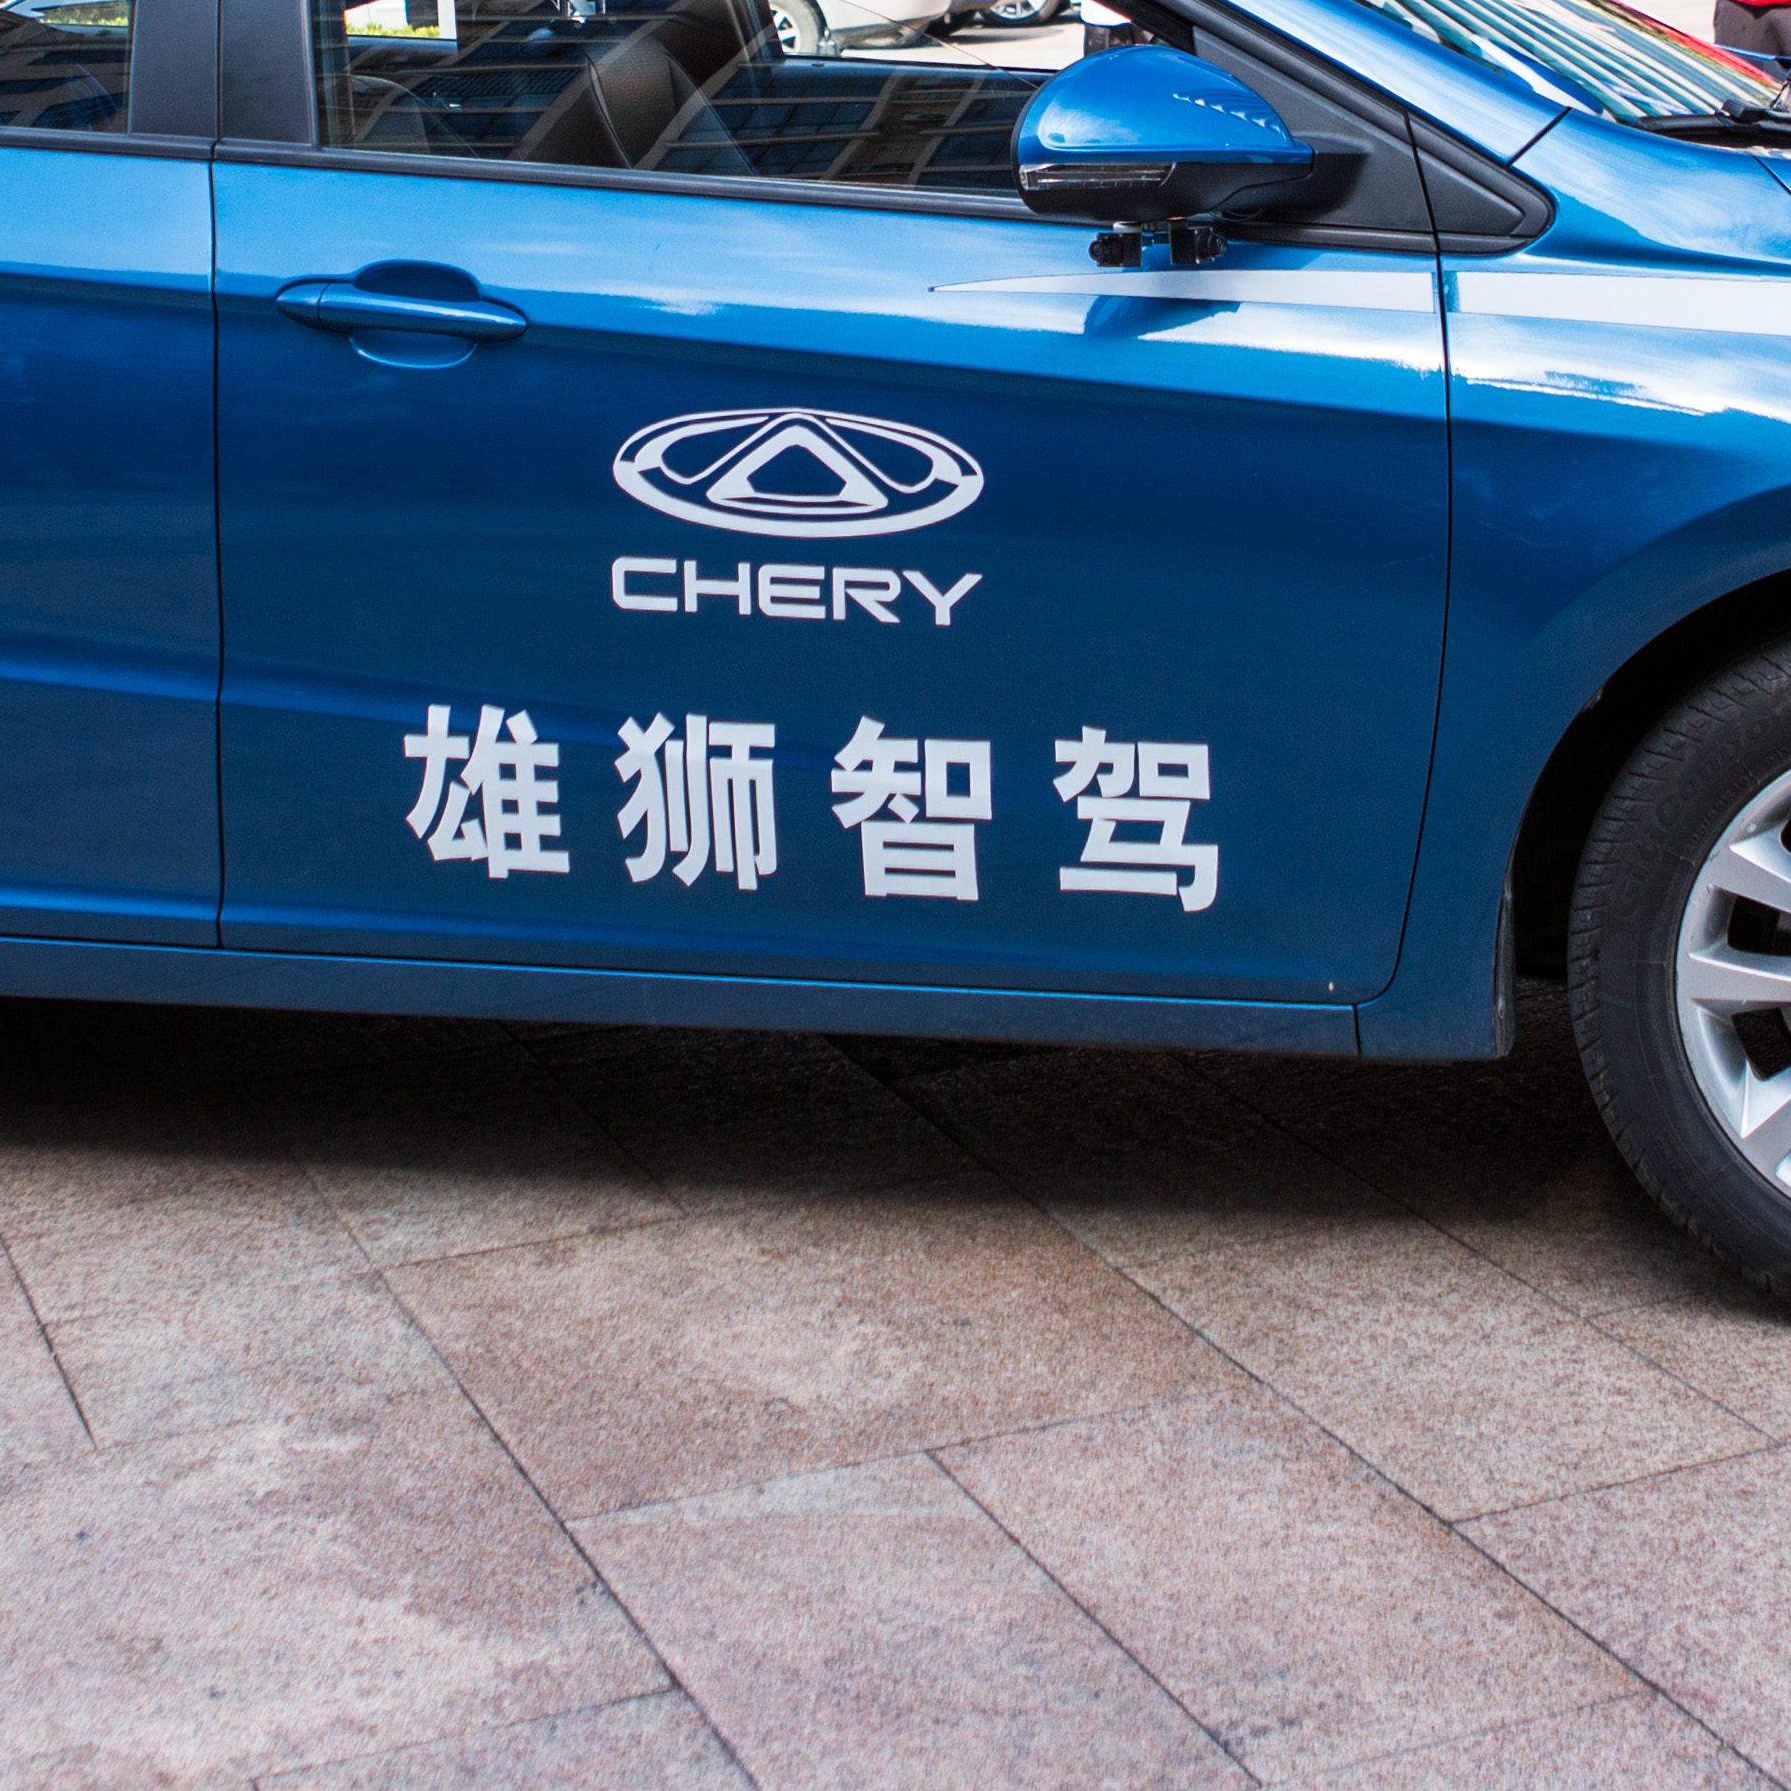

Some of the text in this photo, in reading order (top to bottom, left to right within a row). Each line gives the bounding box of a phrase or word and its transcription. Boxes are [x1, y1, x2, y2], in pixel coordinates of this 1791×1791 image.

[611, 556, 984, 628] CHERY
[403, 702, 1222, 913] 雄狮智驾
